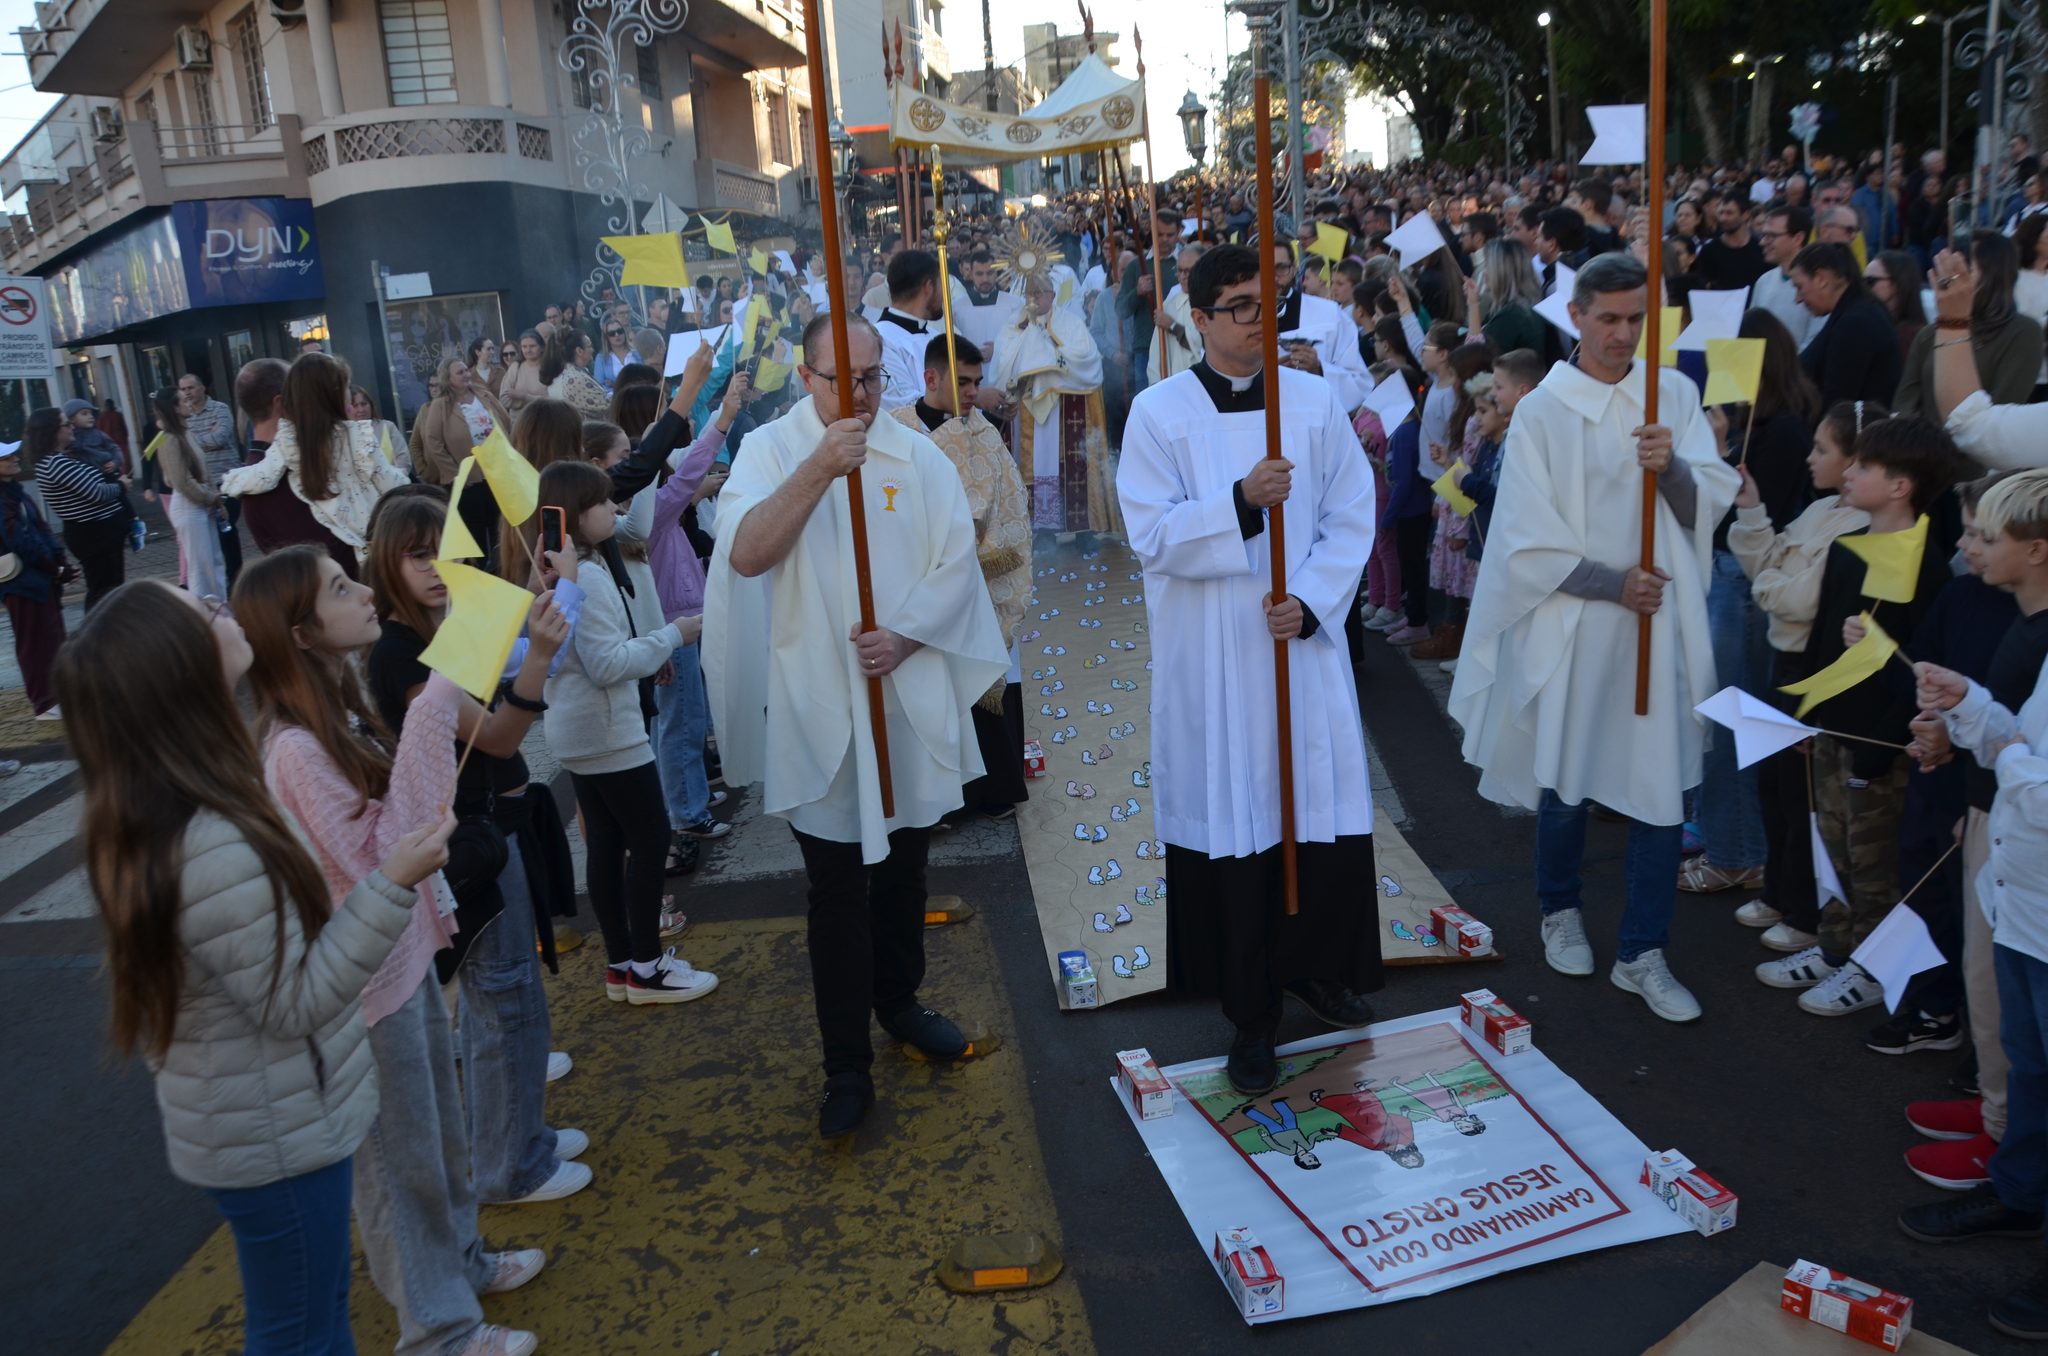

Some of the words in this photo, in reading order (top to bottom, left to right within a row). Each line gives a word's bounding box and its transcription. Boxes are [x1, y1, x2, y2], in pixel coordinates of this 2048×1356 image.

[2, 333, 38, 341] PROIBIDO
[1460, 1164, 1563, 1210] JESUS
[1341, 1196, 1460, 1248] CRISTO
[1431, 1187, 1595, 1251] CAMINHANDO
[1366, 1240, 1429, 1272] COM
